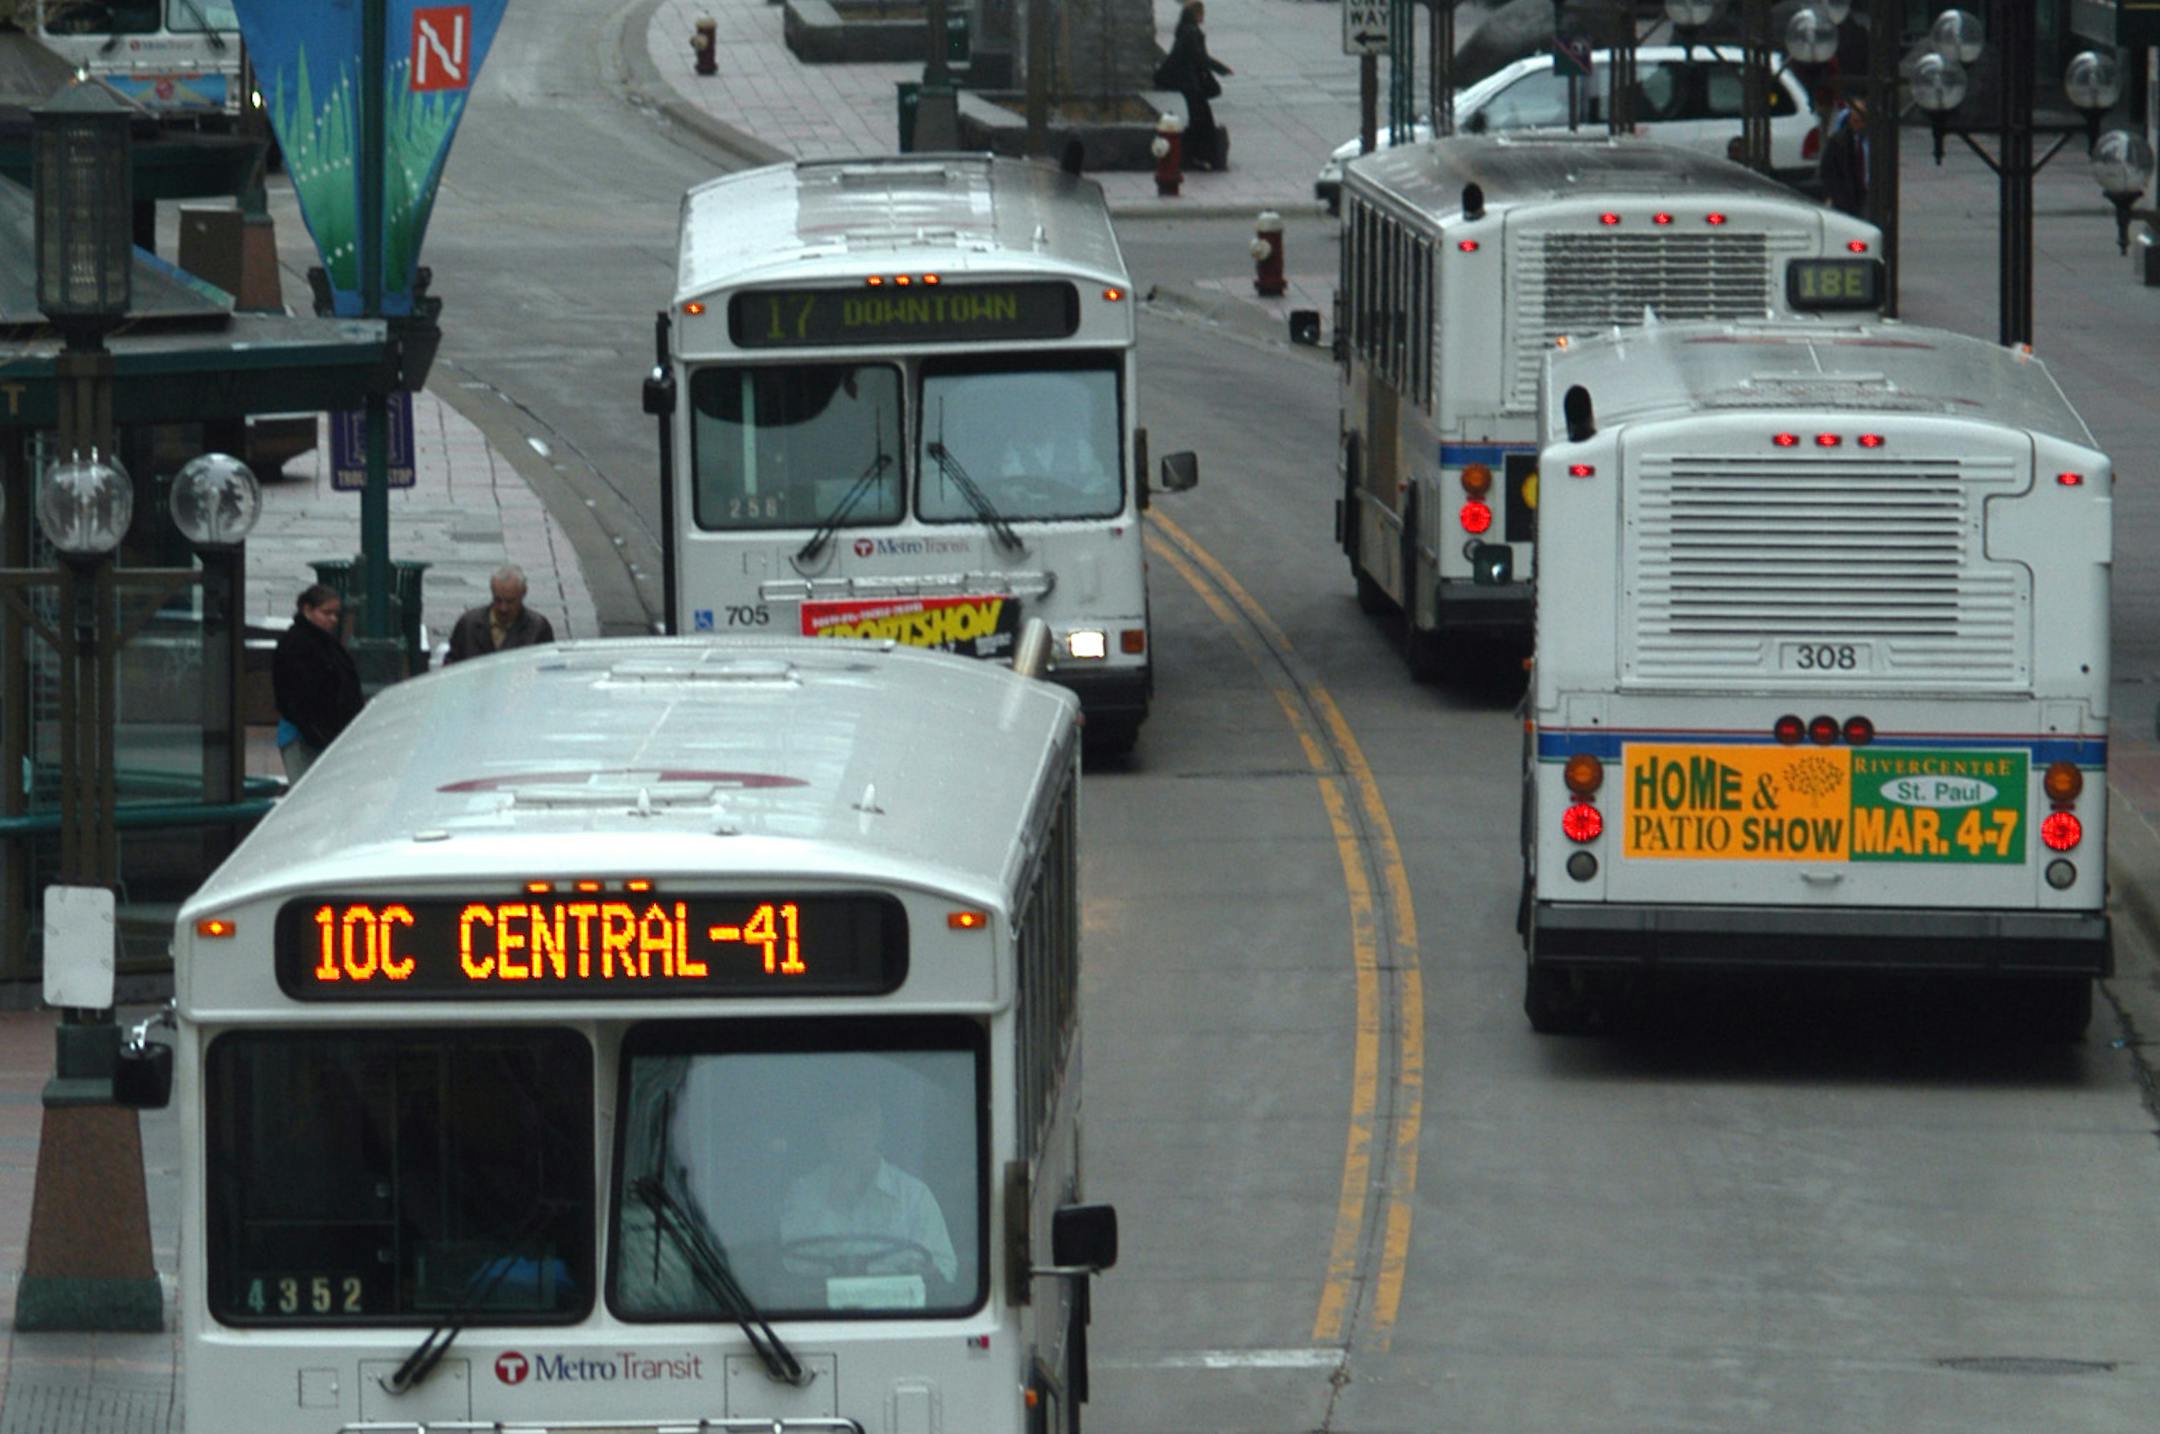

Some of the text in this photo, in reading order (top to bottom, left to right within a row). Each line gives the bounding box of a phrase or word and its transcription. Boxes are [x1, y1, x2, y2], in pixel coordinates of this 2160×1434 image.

[1350, 10, 1391, 26] WAY
[1801, 266, 1864, 298] 18E
[767, 292, 1017, 339] 17 DOWNTOWN
[725, 605, 770, 626] 705
[1796, 645, 1856, 670] 308
[1633, 755, 1780, 811] HOME &
[1897, 781, 1981, 801] St. Paul
[1632, 815, 1843, 853] PATIO SHOW
[1854, 806, 2019, 856] MAR. 4-7
[314, 904, 416, 982] 10C
[247, 1278, 363, 1313] 4352
